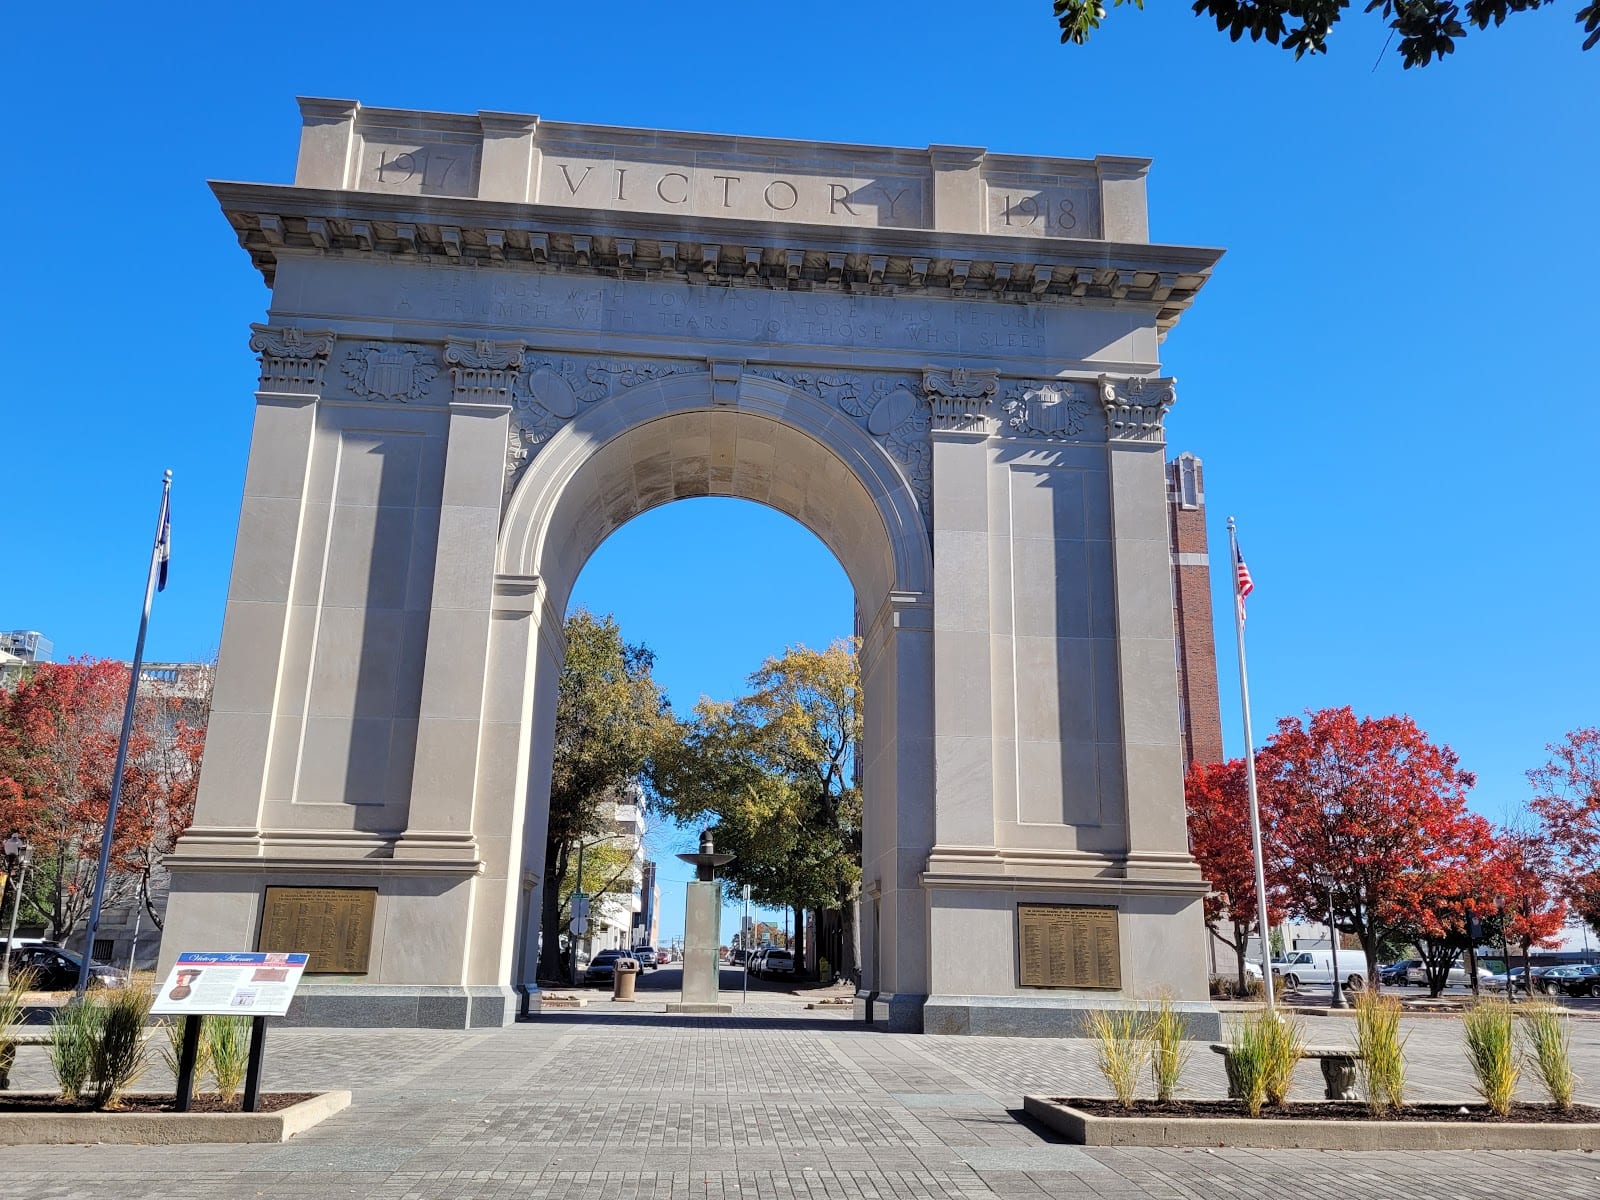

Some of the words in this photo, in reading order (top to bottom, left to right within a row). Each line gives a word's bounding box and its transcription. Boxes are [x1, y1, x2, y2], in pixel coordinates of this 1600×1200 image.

[375, 151, 459, 189] 1917
[557, 163, 910, 219] VICTORY
[1001, 194, 1077, 230] 1918
[438, 298, 549, 320] TRIUMPH
[573, 305, 636, 325] WITH
[660, 312, 729, 331] TEARS
[751, 317, 782, 335] TO
[804, 321, 883, 341] THOSE
[907, 328, 959, 345] WHO
[979, 331, 1047, 350] SLEEP
[647, 291, 706, 310] LOVE
[728, 296, 760, 312] TO
[779, 300, 858, 319] THOSE
[882, 303, 934, 323] WHO
[953, 309, 1047, 331] RETURN
